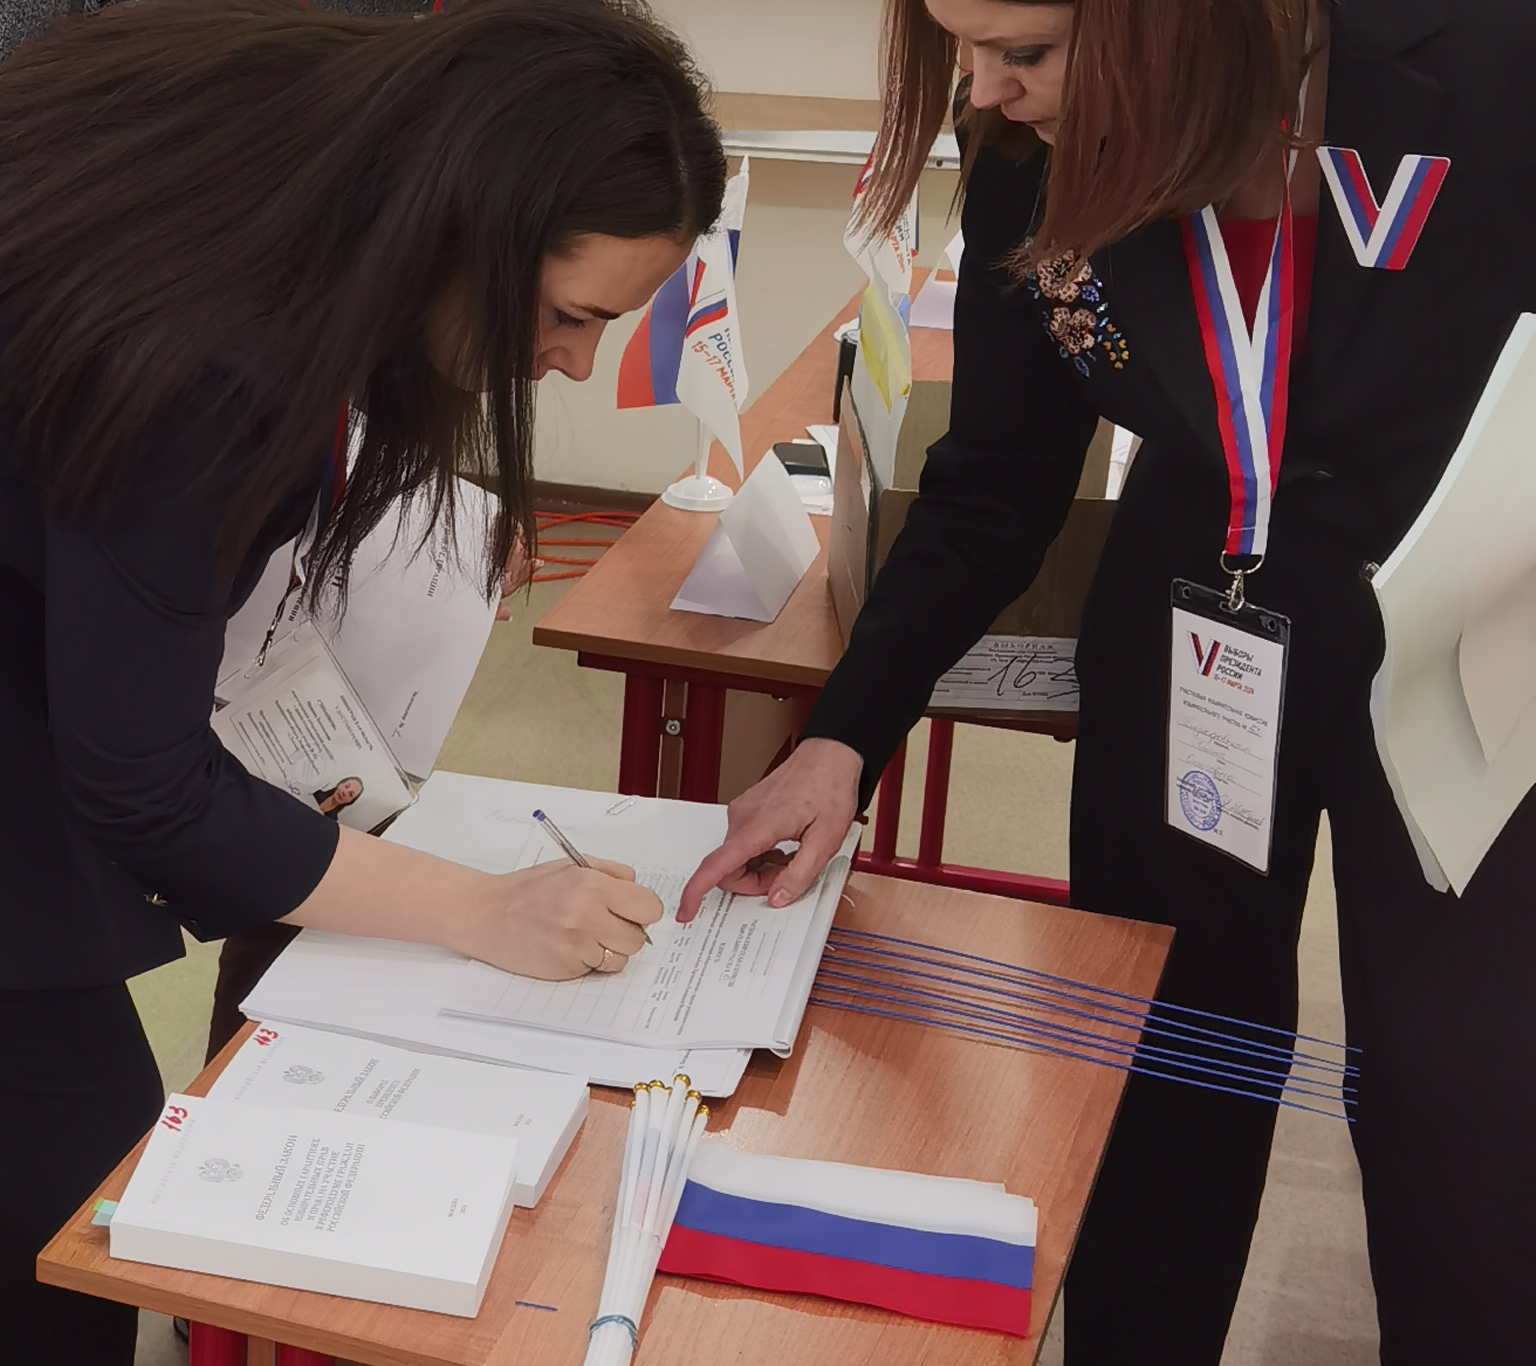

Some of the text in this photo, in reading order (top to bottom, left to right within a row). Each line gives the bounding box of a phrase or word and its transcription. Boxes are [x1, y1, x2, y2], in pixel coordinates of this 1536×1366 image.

[333, 1076, 365, 1113] ЕДЕРАЛЬНЫЙ
[161, 1105, 188, 1132] 163
[255, 1134, 298, 1221] ФЕДЕРАЛЬНЫЙ ЗАКОН
